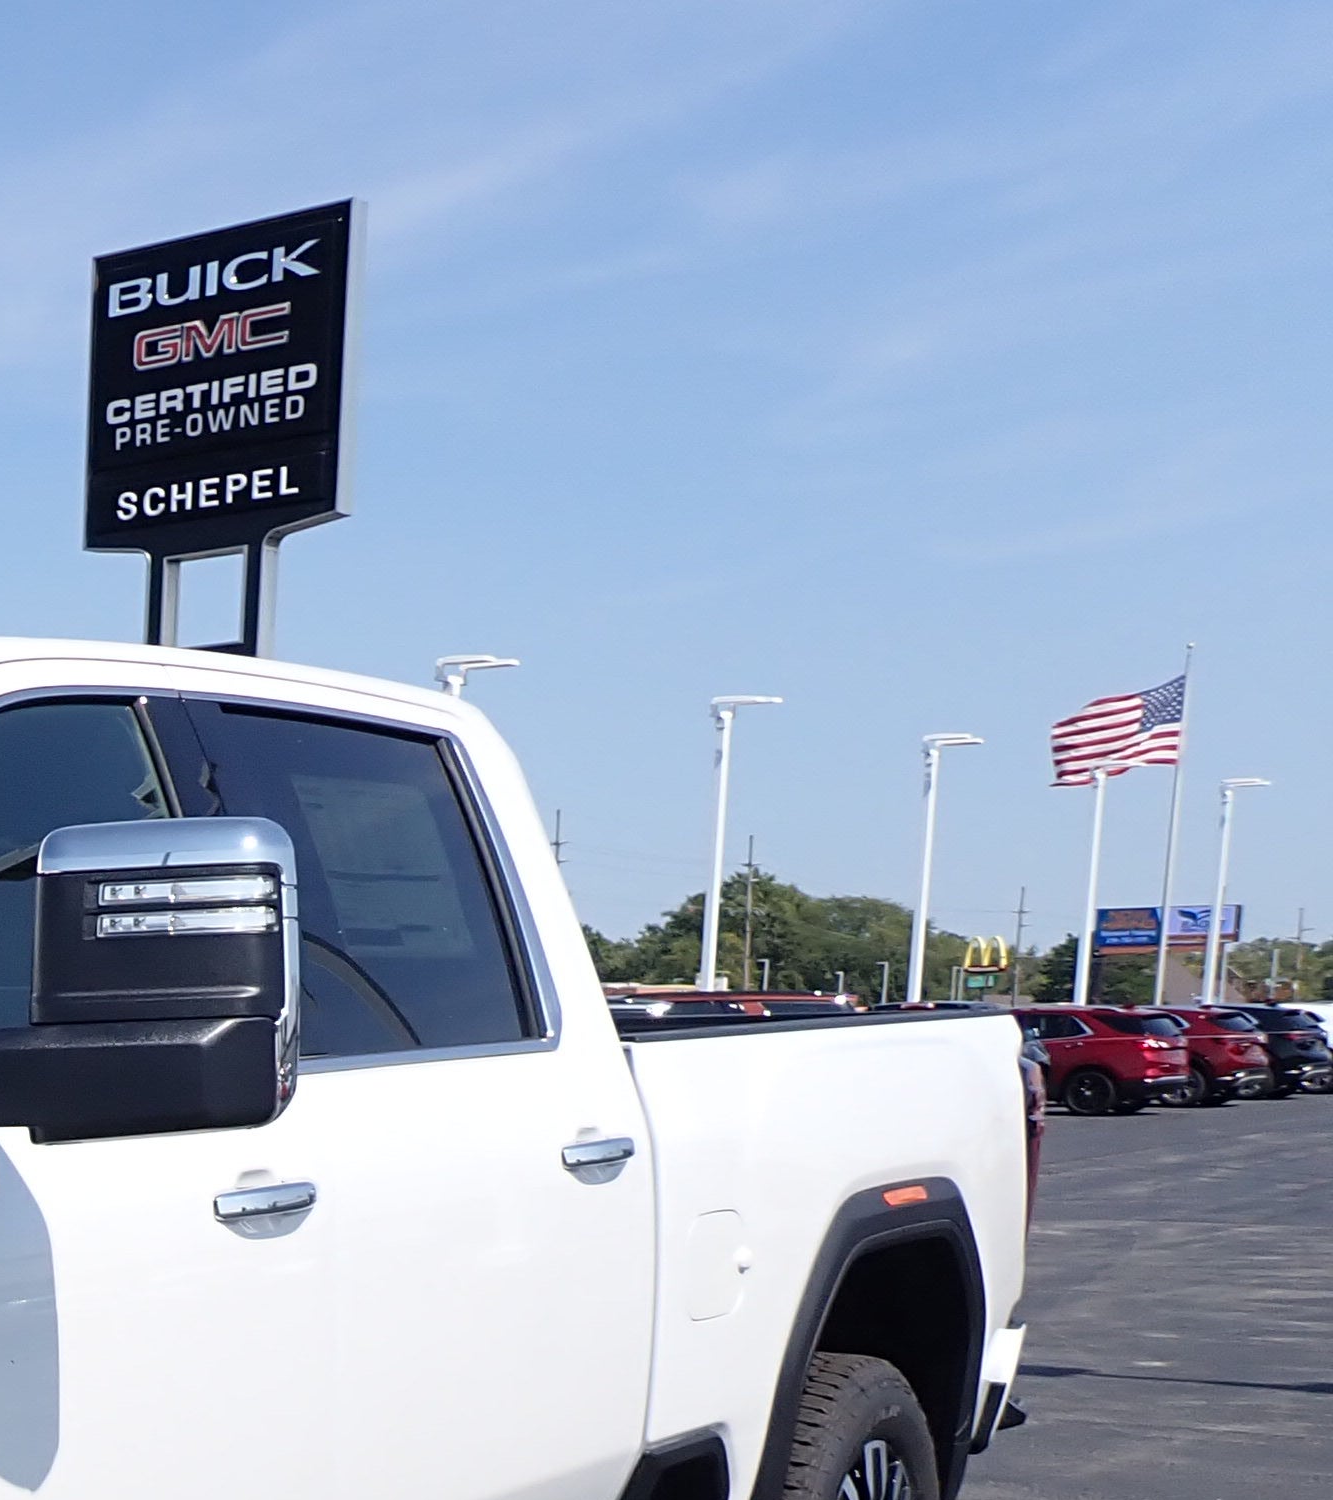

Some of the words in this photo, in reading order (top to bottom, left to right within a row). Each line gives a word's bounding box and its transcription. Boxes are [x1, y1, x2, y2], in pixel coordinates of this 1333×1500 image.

[108, 238, 321, 318] BUICK
[133, 301, 292, 371] GMC
[106, 363, 318, 425] CERTIFIED
[115, 395, 305, 451] PRE-OWNED
[116, 466, 299, 521] SCHEPEL
